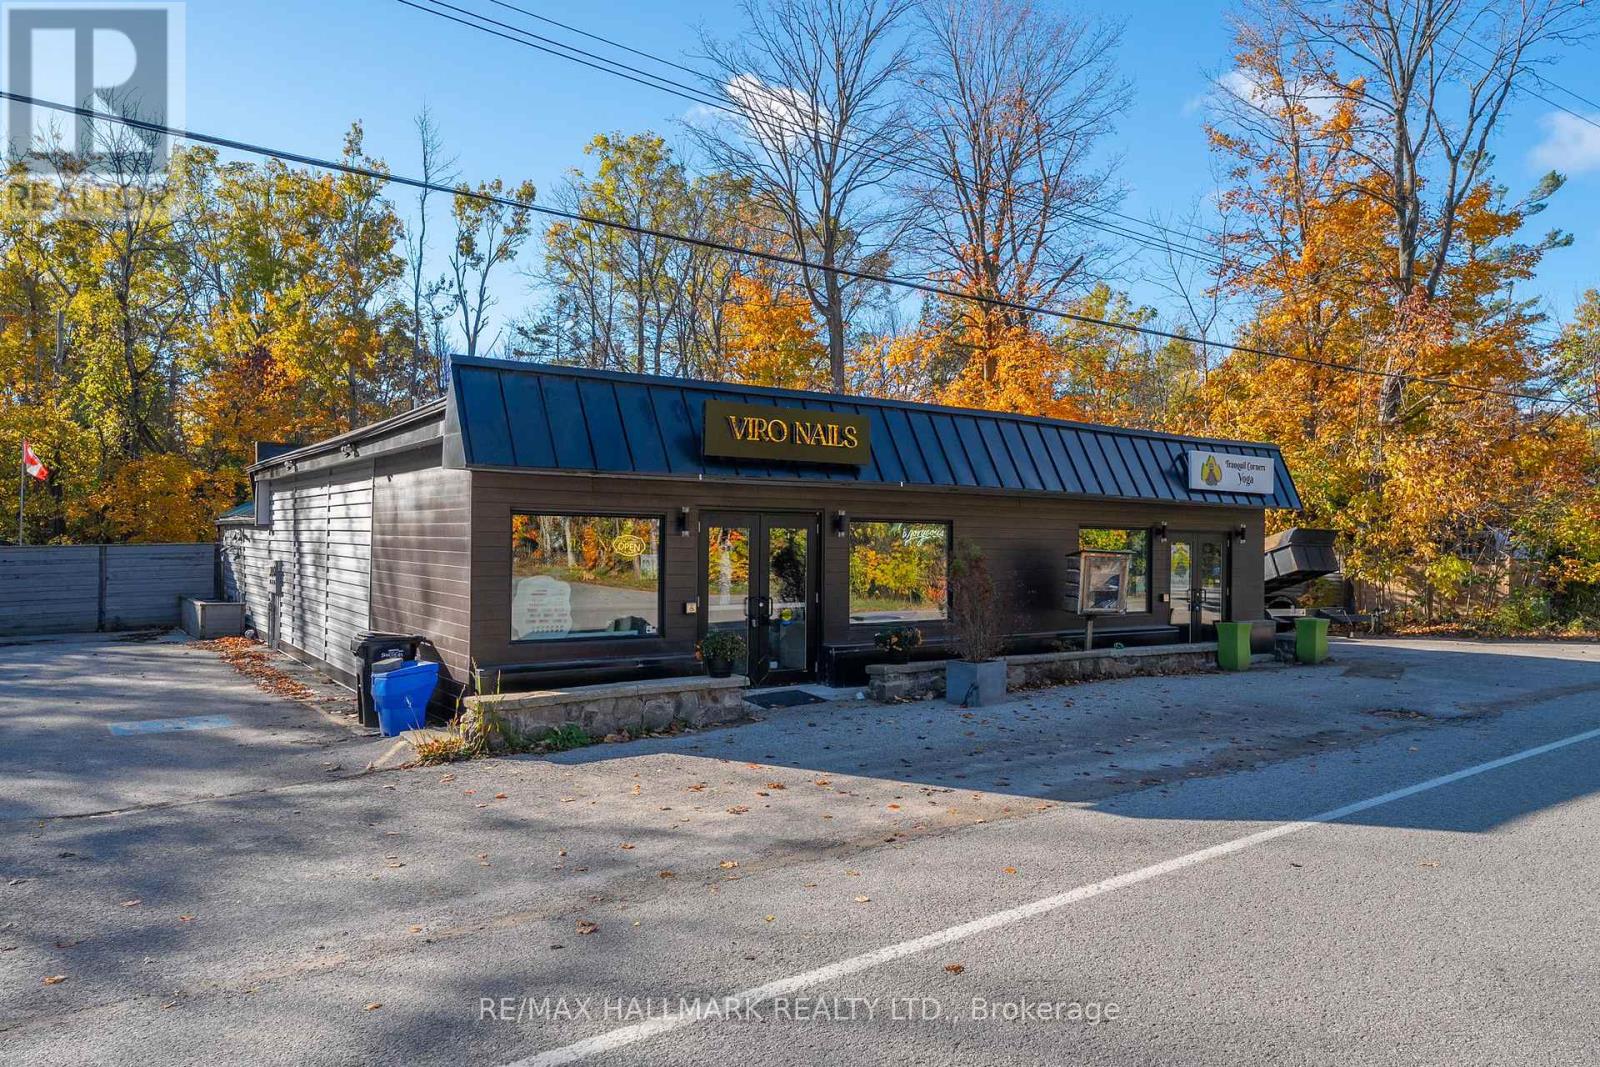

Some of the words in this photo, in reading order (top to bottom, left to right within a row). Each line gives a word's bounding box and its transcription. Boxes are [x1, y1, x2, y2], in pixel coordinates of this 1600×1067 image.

[727, 415, 788, 442] VIRO
[793, 421, 858, 448] NAILS
[1238, 472, 1254, 486] Yoga
[618, 542, 641, 552] OPEN
